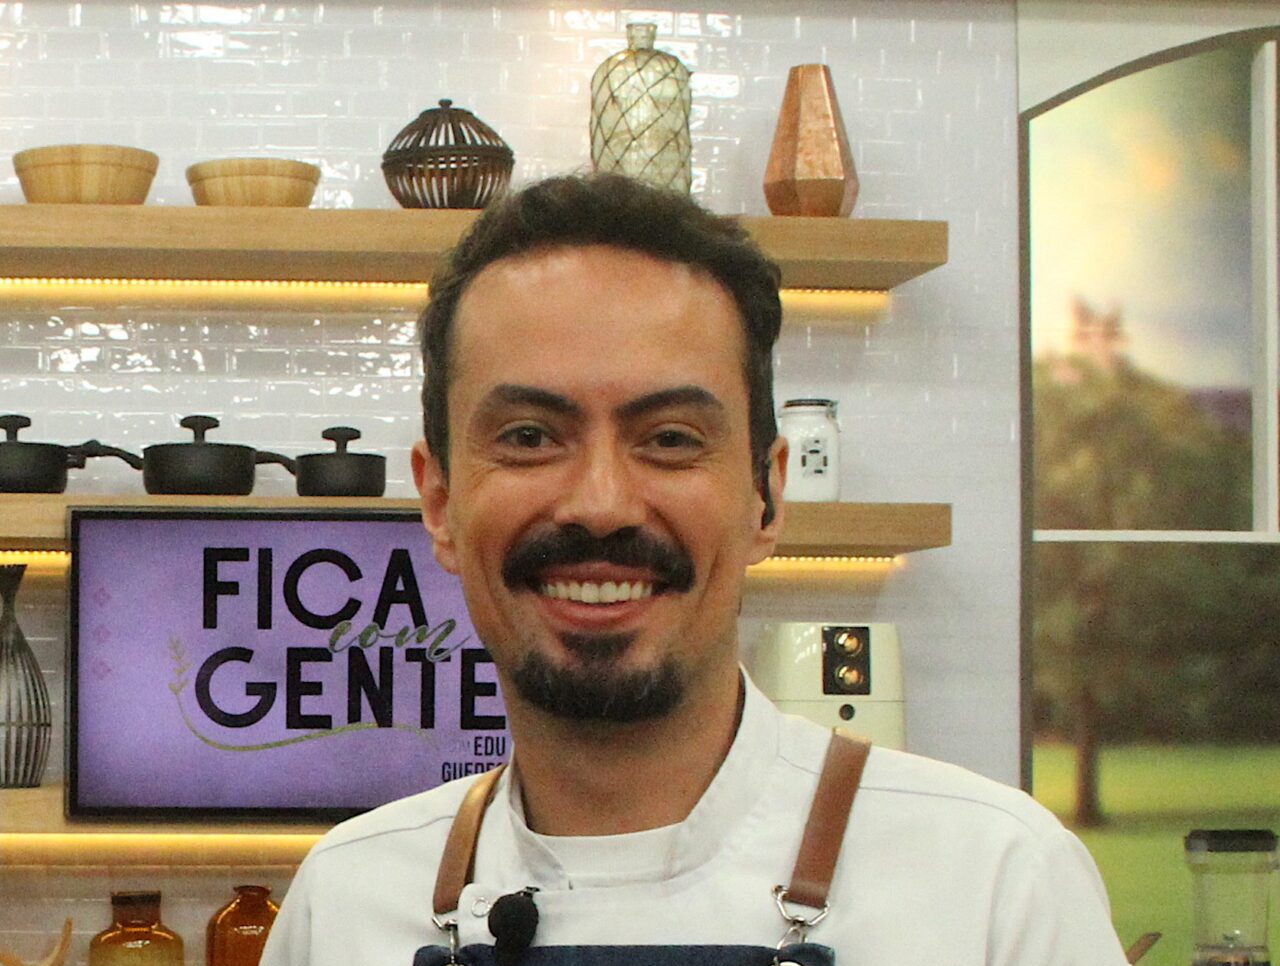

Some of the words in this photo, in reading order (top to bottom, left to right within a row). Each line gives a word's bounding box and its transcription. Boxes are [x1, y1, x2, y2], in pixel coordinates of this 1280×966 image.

[202, 547, 429, 631] FICA
[328, 618, 472, 662] com
[195, 646, 507, 729] GENTE
[473, 736, 506, 756] EDU
[441, 762, 504, 783] GUED
